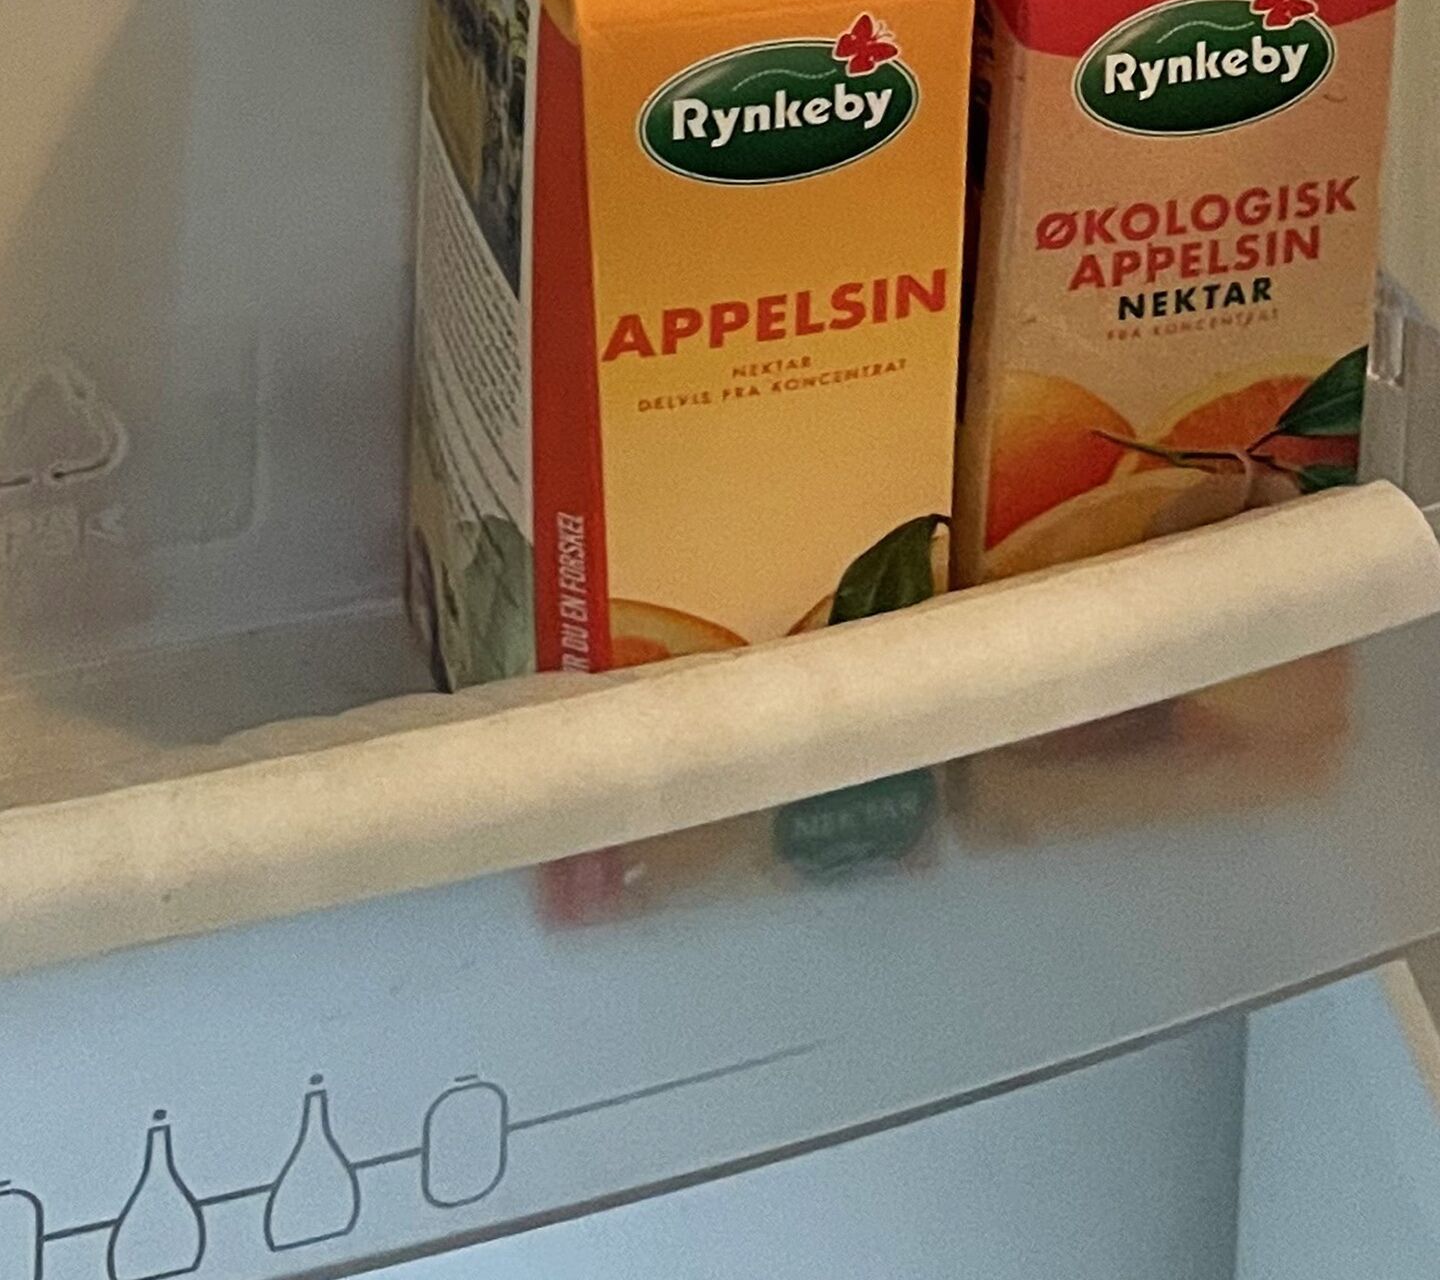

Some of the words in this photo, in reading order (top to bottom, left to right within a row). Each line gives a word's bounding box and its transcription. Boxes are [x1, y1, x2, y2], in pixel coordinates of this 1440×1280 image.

[1104, 34, 1309, 100] Rynkeby
[671, 82, 894, 148] Rynkeby
[1035, 174, 1361, 252] ØKOLOGISK
[1068, 225, 1320, 292] APPELSIN
[601, 267, 948, 364] APPELSIN
[1117, 276, 1272, 321] NEKTAR
[731, 355, 812, 379] NEKTAR
[770, 357, 908, 392] KONCENTRAT
